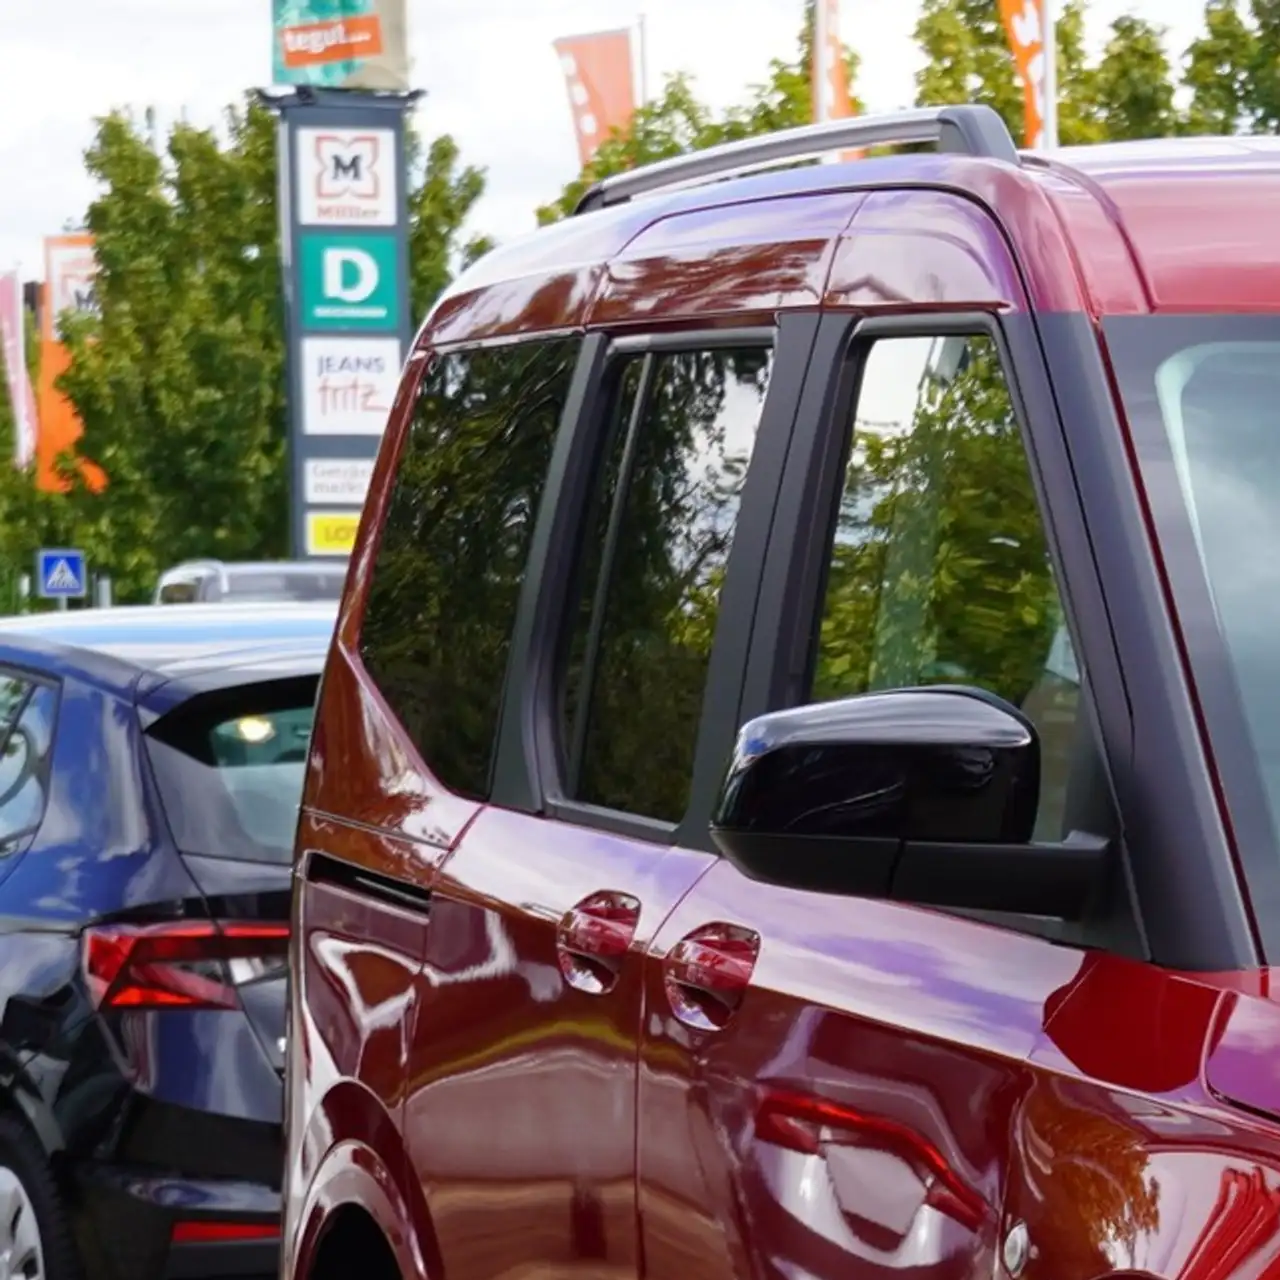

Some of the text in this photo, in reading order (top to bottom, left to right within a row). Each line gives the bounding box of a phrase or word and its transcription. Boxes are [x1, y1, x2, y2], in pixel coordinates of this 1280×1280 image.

[332, 154, 361, 180] M
[323, 248, 379, 303] D
[317, 356, 384, 376] JEANS
[318, 376, 388, 415] fritz
